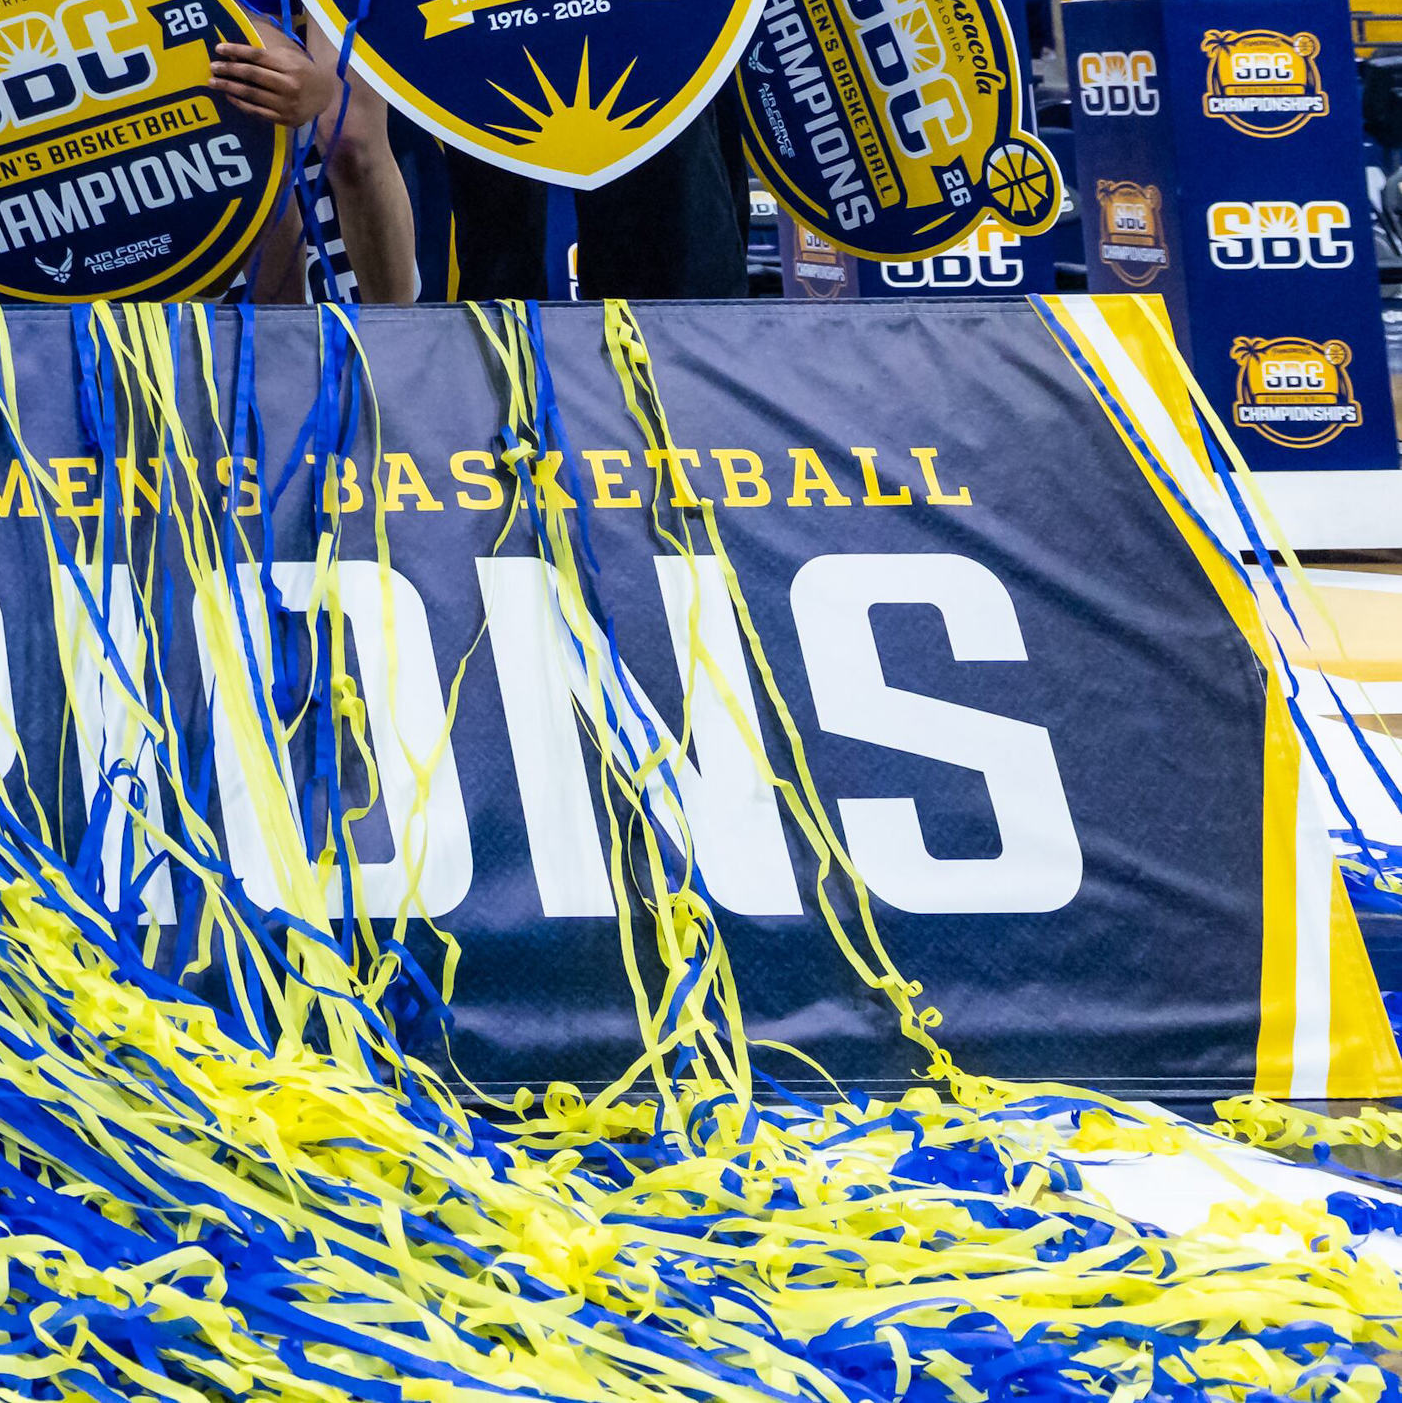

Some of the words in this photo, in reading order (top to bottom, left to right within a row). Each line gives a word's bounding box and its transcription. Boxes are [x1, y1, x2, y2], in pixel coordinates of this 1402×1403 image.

[164, 2, 208, 36] 26
[487, 7, 539, 31] 1976
[1078, 50, 1159, 116] SBC
[1232, 53, 1294, 82] SBC
[1209, 95, 1323, 114] CHAMPIONSHIPS
[48, 104, 208, 165] BASKETBALL
[831, 58, 893, 198] BASKETBALL
[1206, 200, 1355, 270] SBC
[1262, 360, 1325, 389] SBC
[1239, 406, 1356, 423] CHAMPIONSHIPS
[305, 447, 974, 514] BASKETBALL
